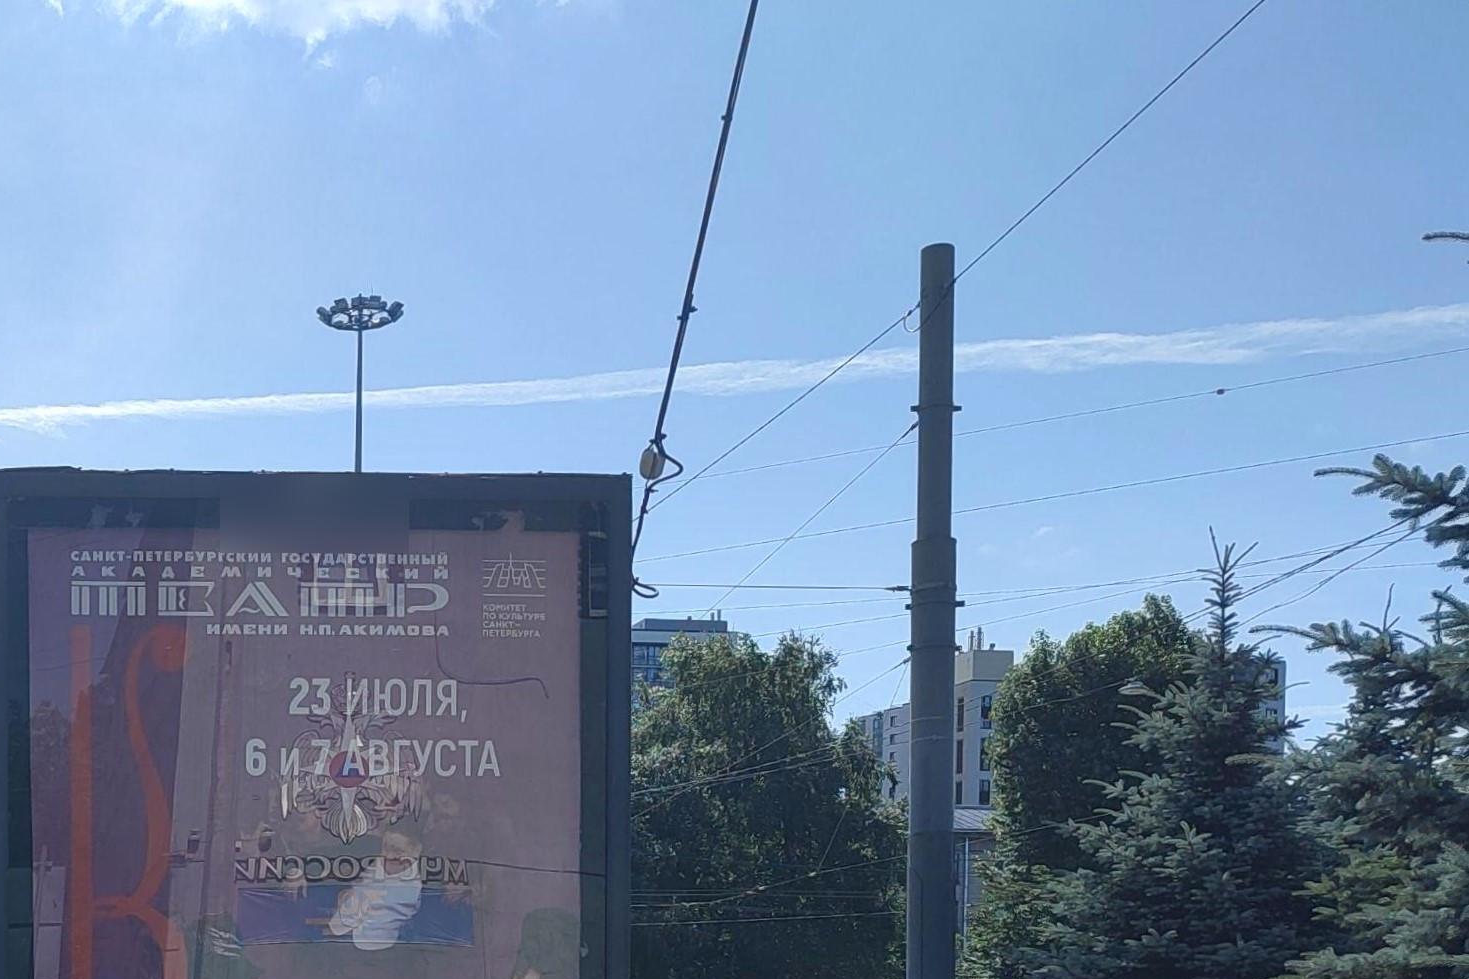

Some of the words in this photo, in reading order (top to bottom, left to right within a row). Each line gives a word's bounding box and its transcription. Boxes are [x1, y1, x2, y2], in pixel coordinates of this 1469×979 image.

[281, 552, 449, 565] ГОСУДАРСТВЕННЫЙ
[70, 566, 449, 580] АКАДЕМИЧЕСКИЙ
[482, 612, 497, 620] ПО
[206, 623, 289, 636] ИМЕНИ
[288, 677, 332, 716] 23
[346, 678, 468, 723] ИЮЛЯ,
[245, 738, 267, 777] 6
[311, 739, 332, 776] 7
[342, 738, 501, 777] АВГУСТА
